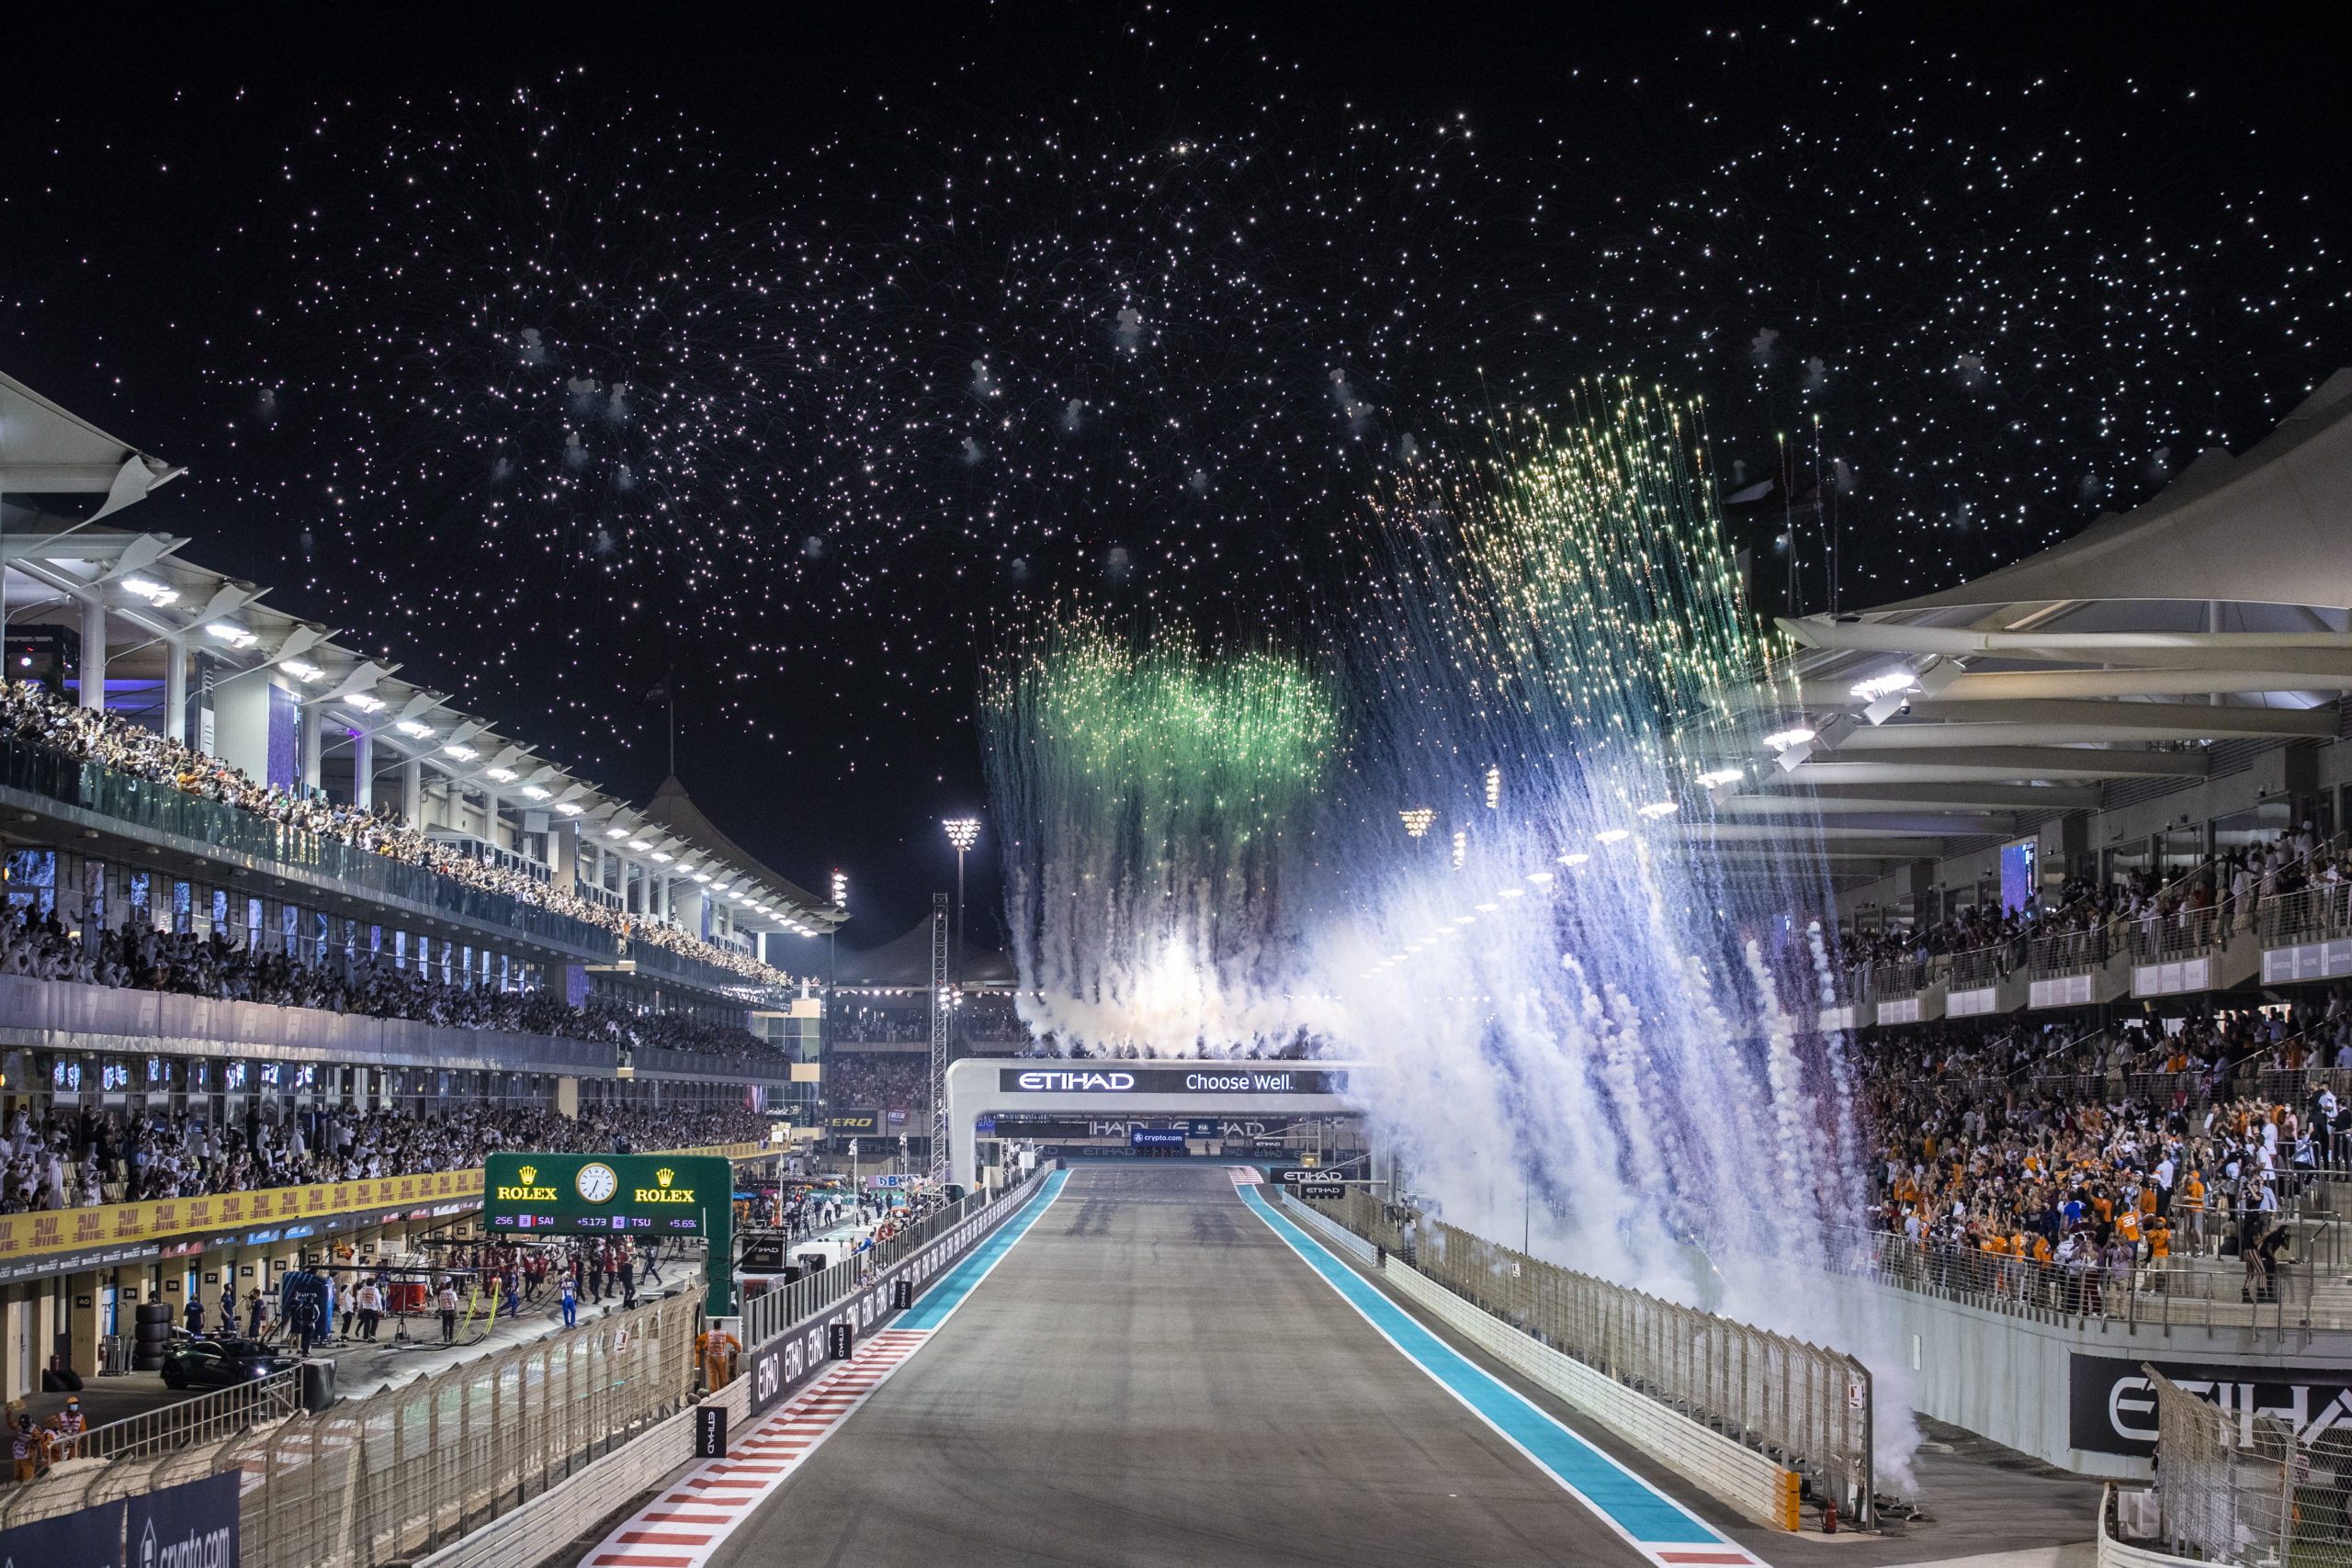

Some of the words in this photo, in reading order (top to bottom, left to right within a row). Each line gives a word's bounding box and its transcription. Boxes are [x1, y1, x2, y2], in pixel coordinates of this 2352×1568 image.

[1019, 1072, 1135, 1090] ETIHAD
[1185, 1074, 1250, 1090] Choose
[1255, 1074, 1295, 1090] Well.
[1144, 1134, 1182, 1143] crypto.com
[857, 1144, 902, 1153] ETIHA
[1082, 1147, 1136, 1156] ETIHAD
[1283, 1171, 1342, 1181] ETIHAD
[497, 1187, 558, 1201] ROLEX
[635, 1189, 695, 1202] ROLEX
[577, 1218, 607, 1226] +5.173
[631, 1218, 651, 1227] TSU
[2123, 1218, 2136, 1227] 33
[808, 1325, 824, 1367] ETIHAD
[785, 1337, 803, 1383] ETIHAD
[758, 1352, 779, 1402] ETIHAD
[161, 1527, 230, 1568] crypto.com
